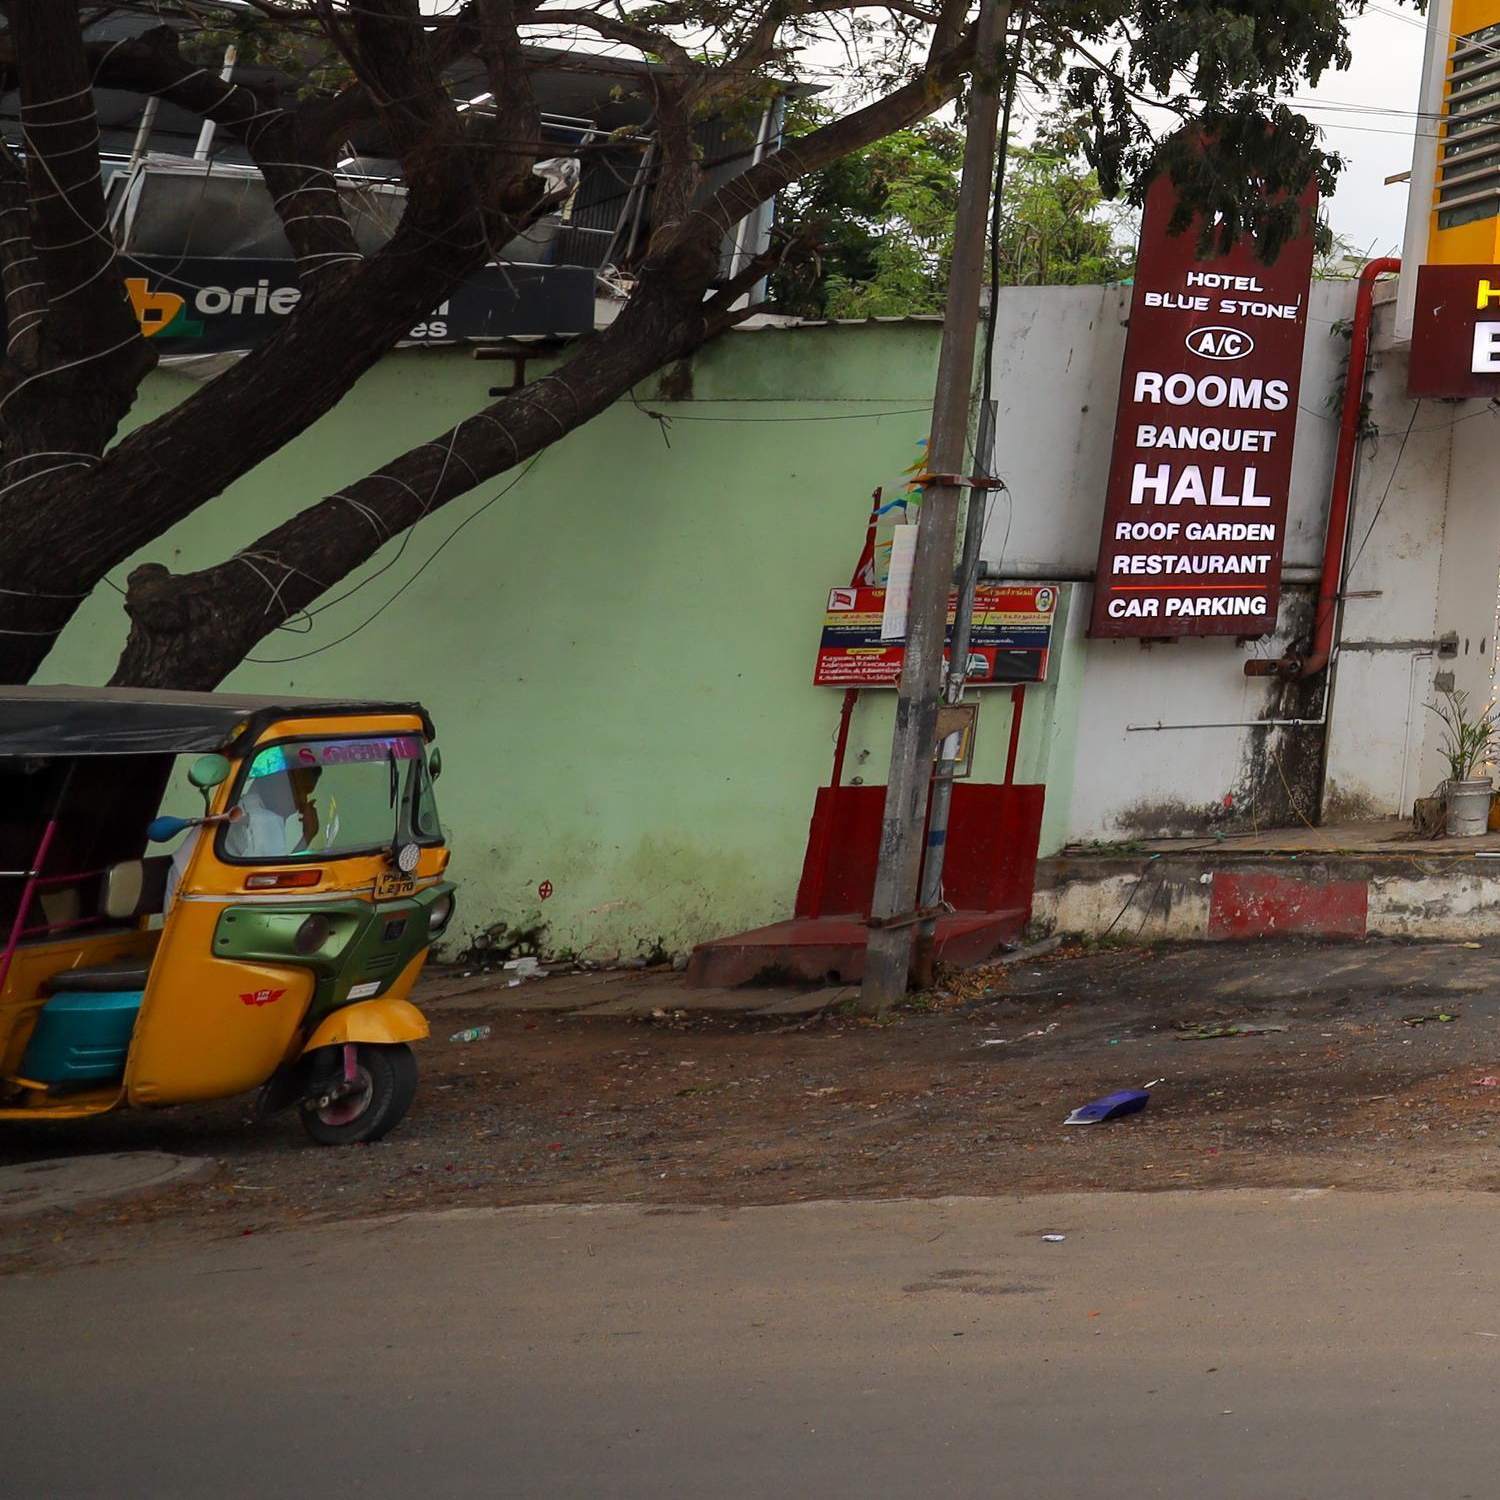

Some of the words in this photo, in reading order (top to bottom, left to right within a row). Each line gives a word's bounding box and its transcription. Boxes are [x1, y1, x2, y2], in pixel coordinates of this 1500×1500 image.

[1187, 272, 1264, 292] HOTEL
[1145, 292, 1210, 311] BLUE
[1219, 300, 1297, 319] STONE
[1198, 333, 1242, 356] A/C
[1133, 371, 1289, 411] ROOMS
[1136, 425, 1277, 452] BANQUET
[1130, 463, 1271, 507] HALL
[1115, 522, 1180, 540] ROOF
[1185, 523, 1276, 541] GARDEN
[1112, 555, 1271, 574] RESTAURANT
[1108, 598, 1159, 618] CAR
[1165, 596, 1267, 616] PARKING
